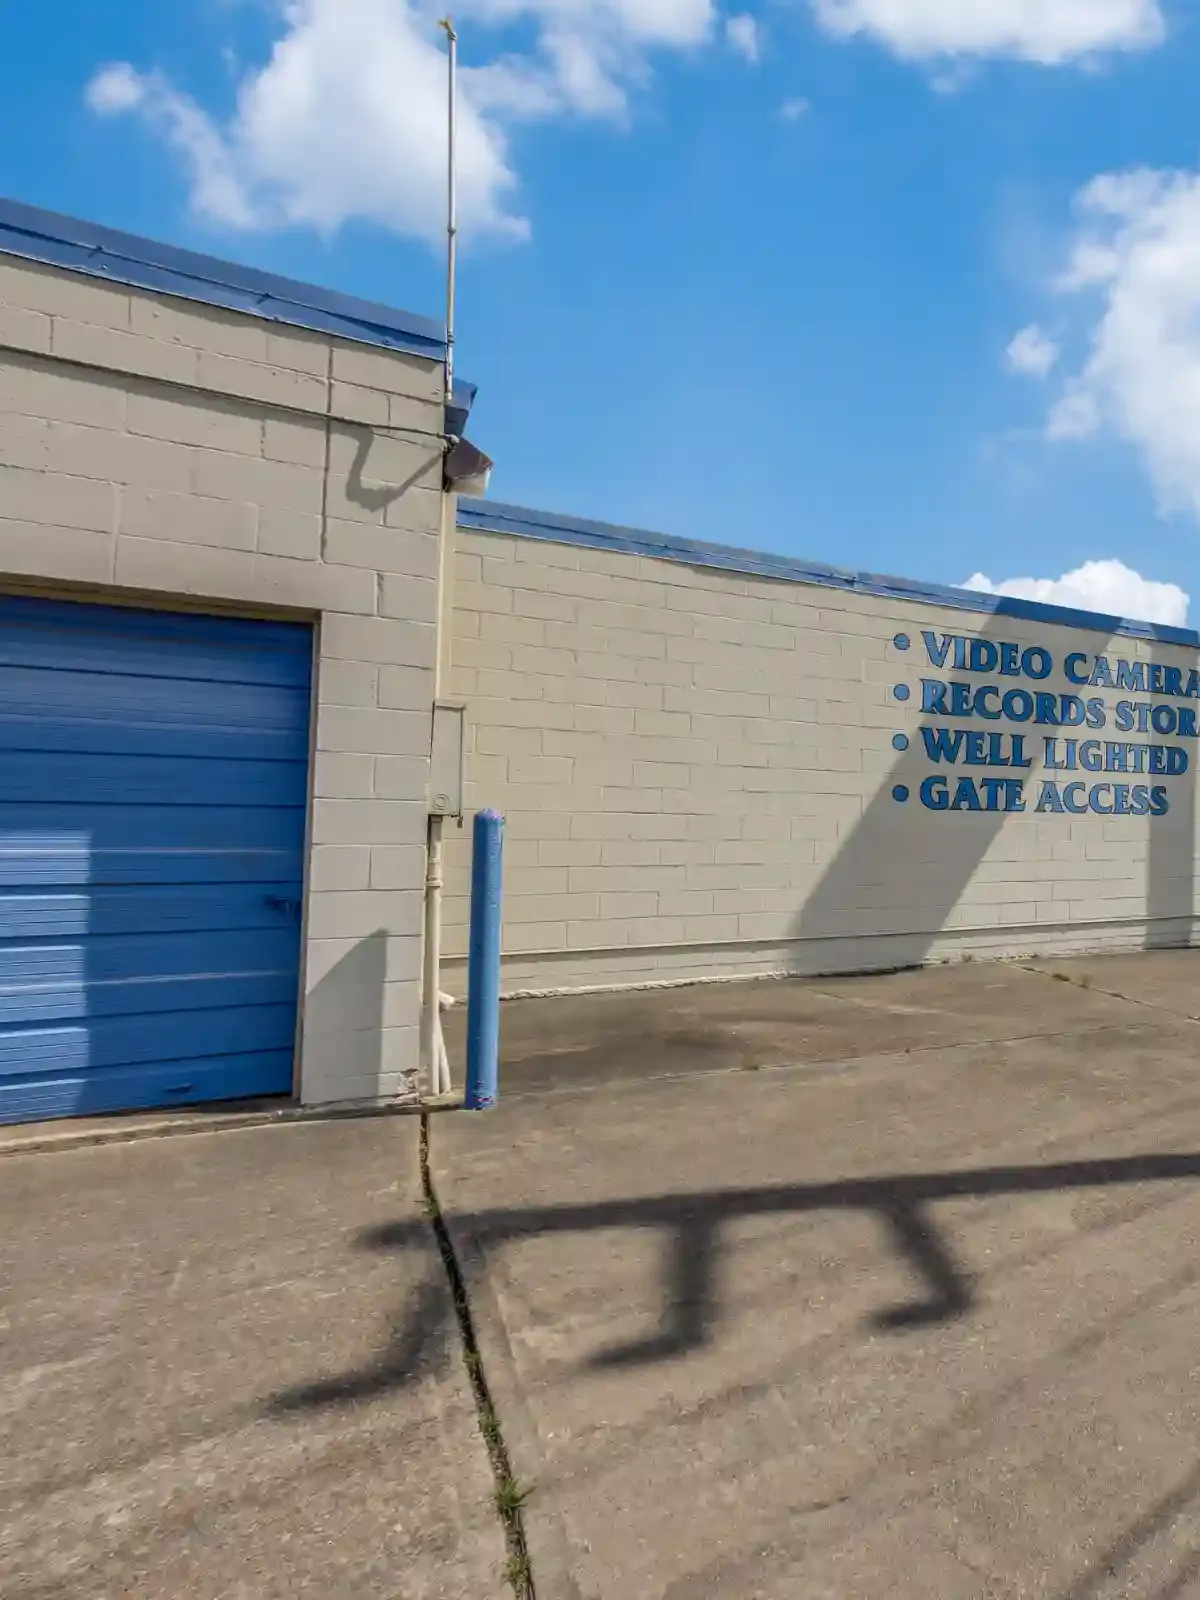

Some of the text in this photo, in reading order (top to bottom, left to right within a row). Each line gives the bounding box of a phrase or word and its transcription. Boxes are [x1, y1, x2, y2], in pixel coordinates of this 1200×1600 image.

[921, 630, 1053, 680] VIDEO
[920, 678, 1106, 729] RECORDS
[919, 727, 1189, 776] WELL LIGHTED
[920, 775, 1170, 816] GATE ACCESS
